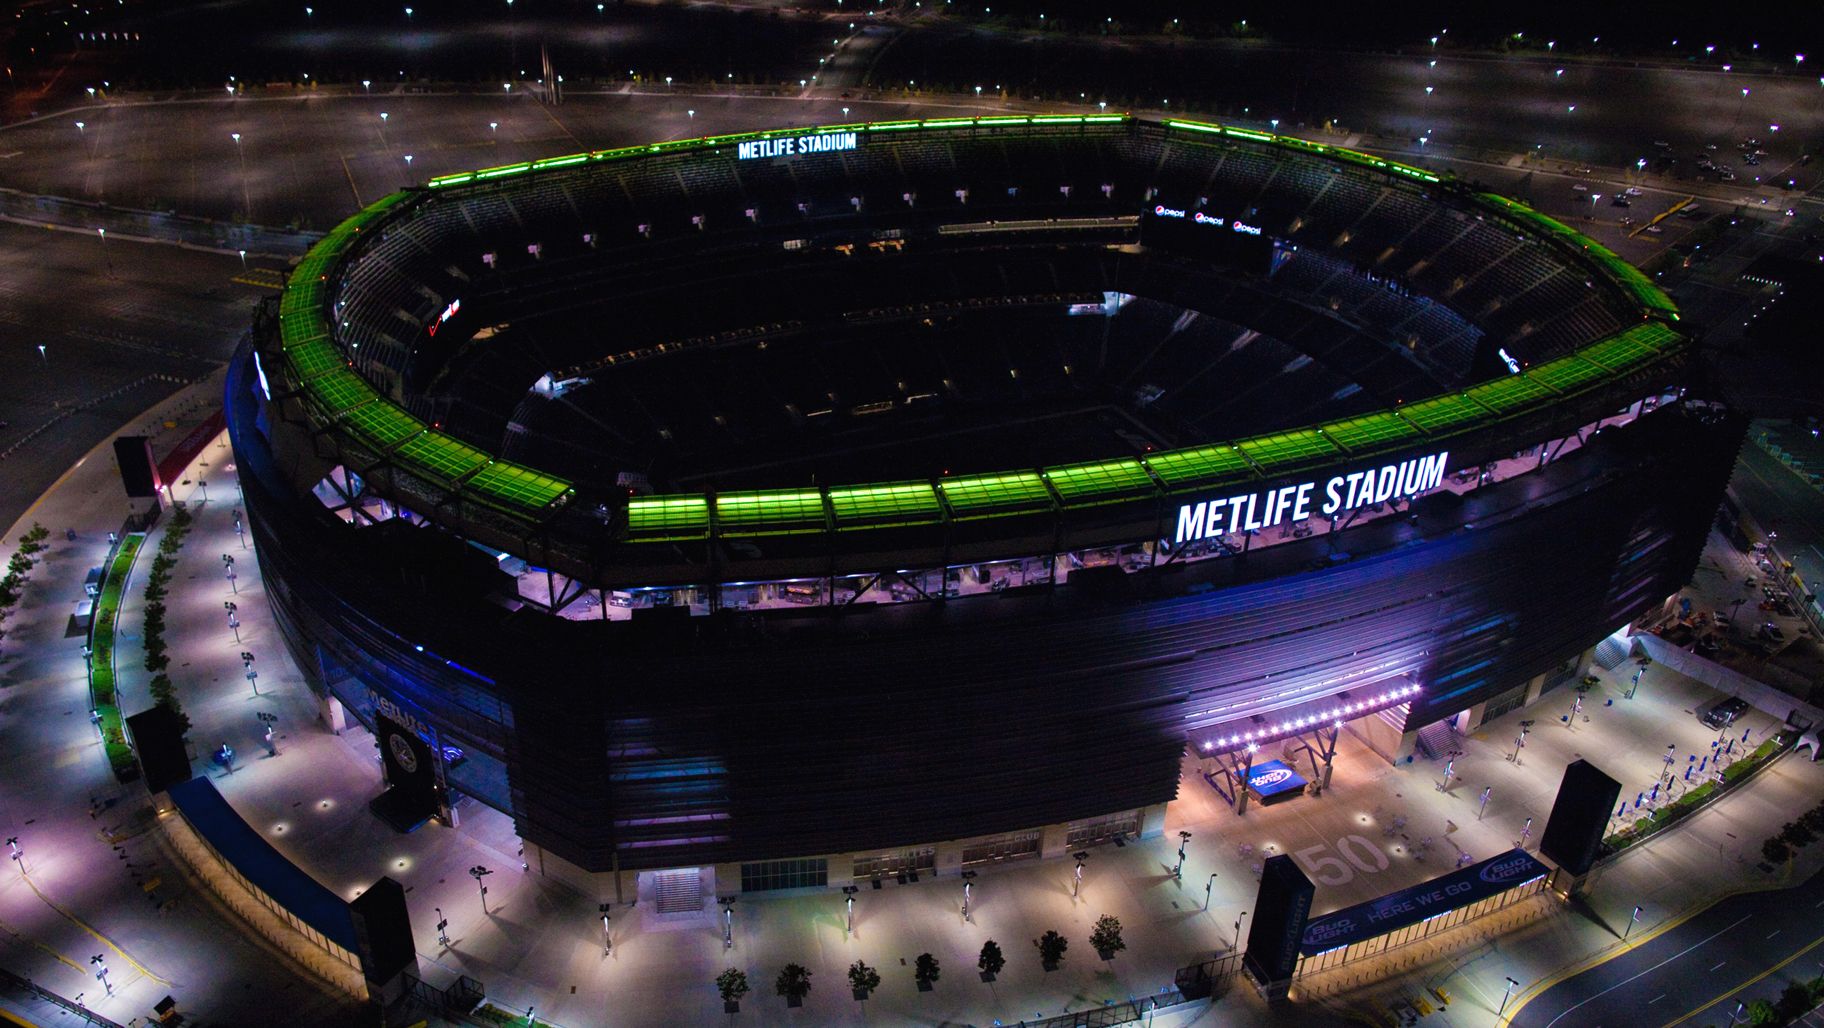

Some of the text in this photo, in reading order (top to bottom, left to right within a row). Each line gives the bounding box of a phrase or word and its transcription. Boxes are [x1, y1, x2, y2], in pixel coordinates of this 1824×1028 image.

[738, 132, 856, 160] METLIFE STADIUM
[1164, 208, 1185, 218] pepsi
[1203, 216, 1224, 226] pepsi
[1241, 225, 1261, 235] pepsi
[1176, 451, 1449, 543] METLIFE STADIUM
[1296, 834, 1390, 887] 50
[1493, 858, 1528, 875] BUD
[1367, 901, 1416, 924] HERE
[1415, 890, 1446, 907] WE
[1445, 880, 1472, 897] GO
[1310, 919, 1351, 936] BUD
